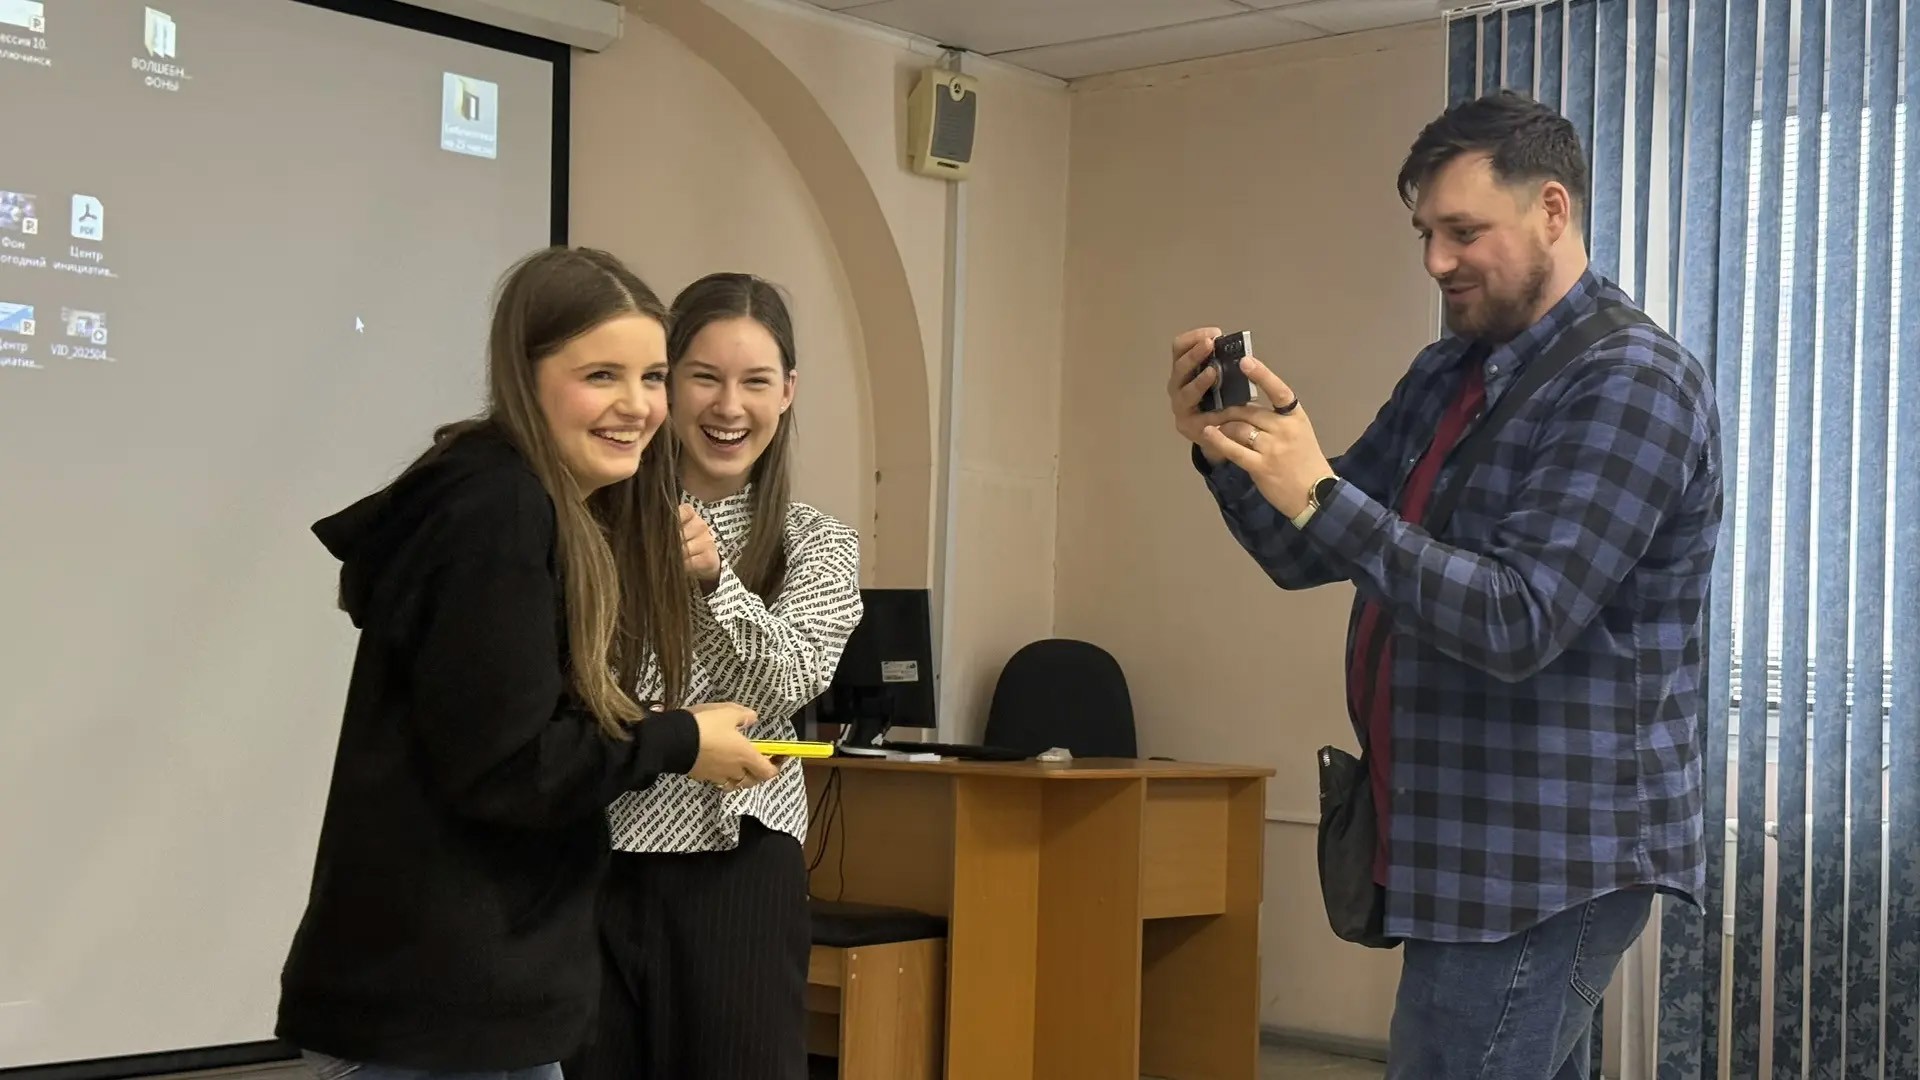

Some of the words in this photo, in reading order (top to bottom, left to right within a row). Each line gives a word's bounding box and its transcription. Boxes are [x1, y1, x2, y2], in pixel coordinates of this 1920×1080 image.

[2, 236, 26, 249] Фон
[70, 245, 103, 263] Центр
[718, 516, 747, 527] REPEAT
[791, 592, 819, 605] REPEAT
[820, 587, 843, 597] REPEAT
[805, 601, 828, 610] REPEAT
[829, 594, 853, 604] REPEAT
[816, 608, 837, 616] REPEAT
[838, 599, 860, 612] REPEAT
[645, 783, 671, 811] REPEAT
[660, 782, 683, 810] REPEAT
[770, 781, 789, 801] REPEAT
[619, 809, 645, 837] REPEAT
[634, 809, 660, 837] REPEAT
[646, 809, 671, 836] REPEAT
[664, 807, 685, 834] REPEAT
[675, 806, 700, 834] REPEAT
